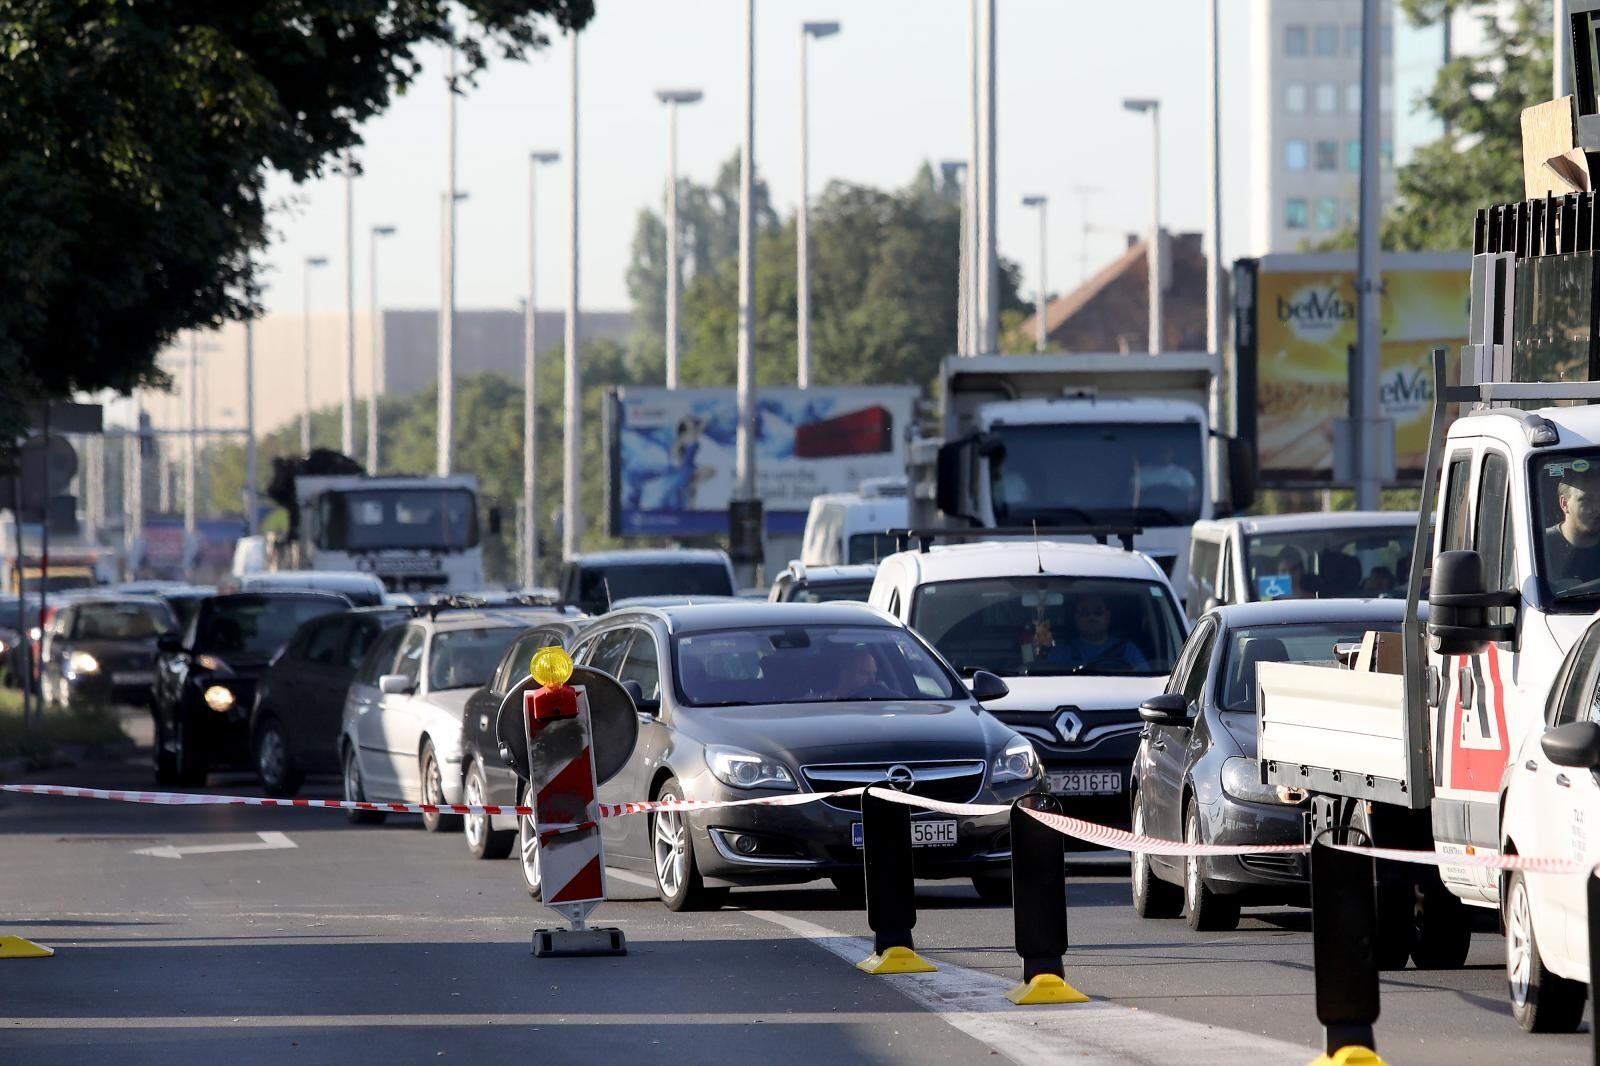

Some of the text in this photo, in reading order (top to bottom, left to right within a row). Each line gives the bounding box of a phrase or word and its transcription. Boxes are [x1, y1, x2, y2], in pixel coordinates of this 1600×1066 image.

[1276, 287, 1355, 320] belVita
[1380, 367, 1433, 403] elVit
[914, 823, 955, 842] 56-HE
